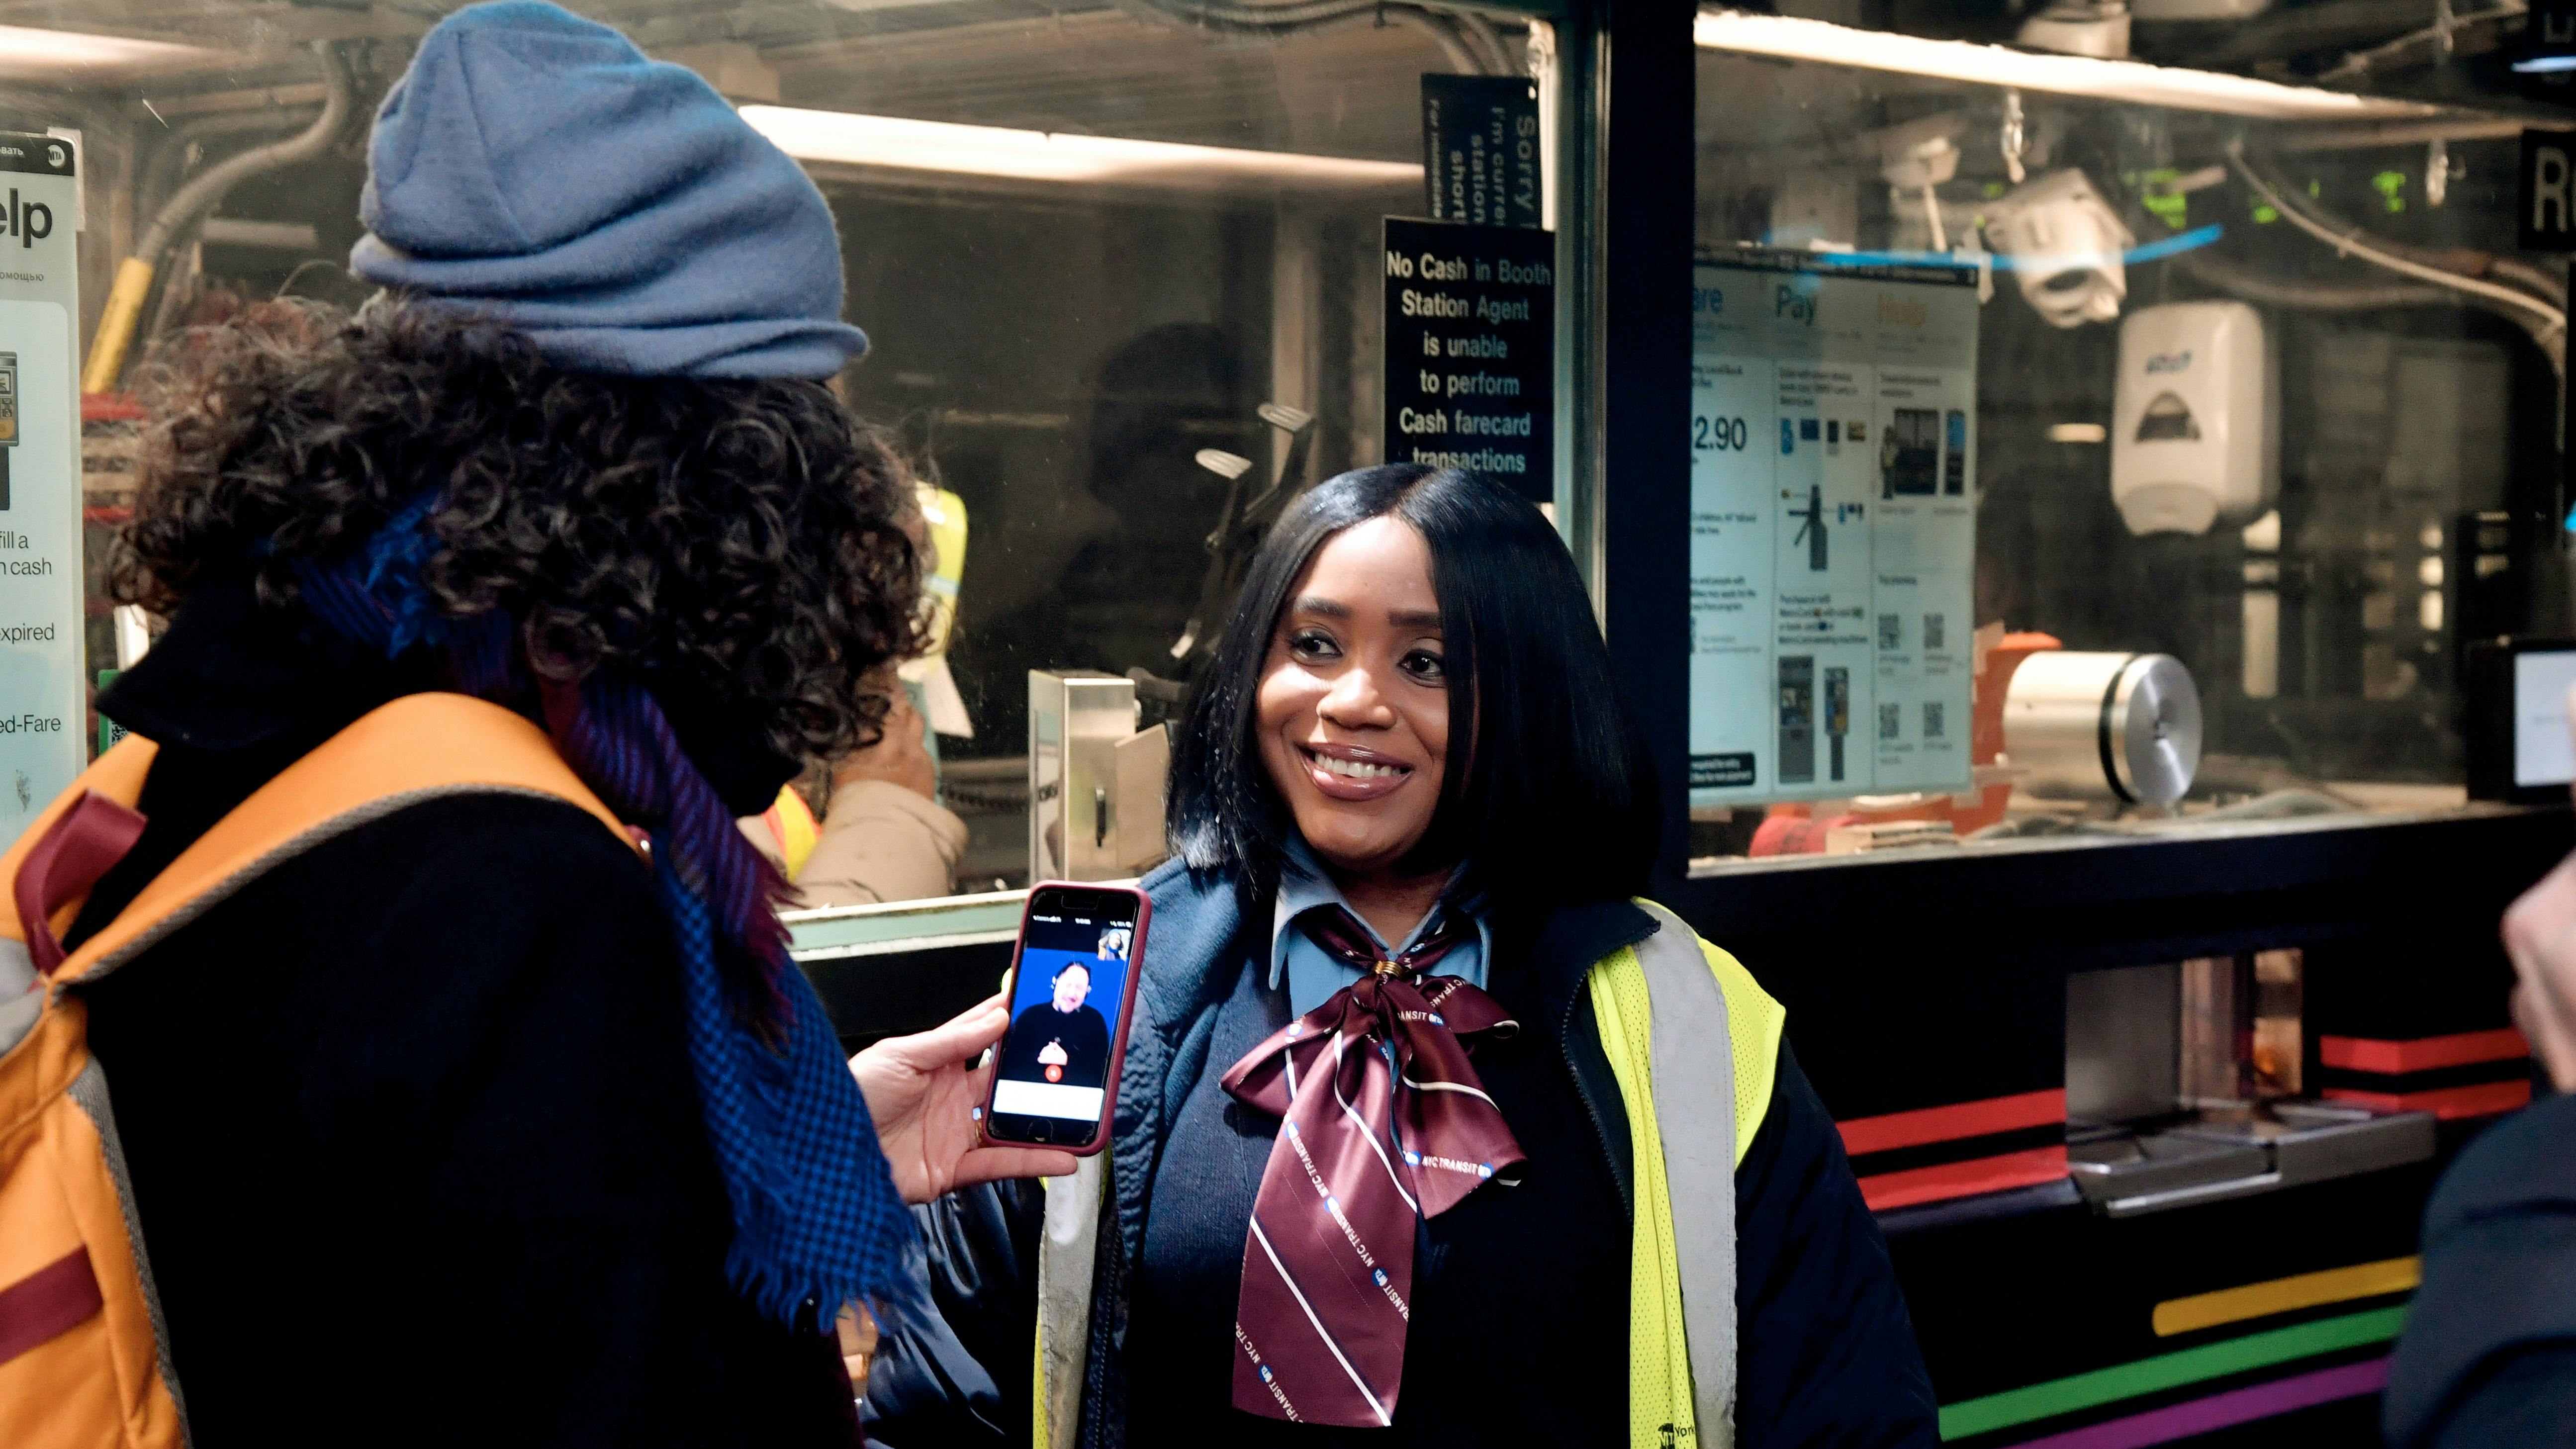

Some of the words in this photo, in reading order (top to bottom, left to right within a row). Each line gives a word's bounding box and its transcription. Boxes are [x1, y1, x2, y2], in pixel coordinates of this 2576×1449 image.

[0, 147, 23, 155] вать
[1514, 115, 1537, 212] Sorry
[1450, 150, 1467, 219] short
[1471, 134, 1486, 223] station
[0, 187, 52, 249] lp
[1386, 250, 1413, 278] No
[1420, 252, 1467, 280] Cash
[1475, 257, 1491, 281] in
[1498, 259, 1551, 285] Booth
[1402, 289, 1469, 317] Station
[1476, 294, 1529, 325] Agent
[1777, 285, 1818, 327] Pay
[1423, 330, 1440, 357] is
[1447, 334, 1507, 359] unable
[1420, 369, 1440, 393] to
[1447, 370, 1519, 398] perform
[1399, 407, 1447, 434] Cash
[1455, 409, 1531, 436] farecard
[1694, 416, 1747, 452] 2.90
[1413, 447, 1525, 472] transactions
[18, 535, 29, 549] a
[10, 557, 52, 575] cash
[0, 622, 54, 644] xpired
[1290, 1135, 1317, 1177] TRANSIT
[1421, 1155, 1439, 1168] NYC
[1439, 1157, 1478, 1175] TRANSIT
[1331, 1209, 1361, 1248] TRANSIT
[1356, 1243, 1375, 1268] NYC
[1244, 1341, 1261, 1364] NYC
[1269, 1381, 1298, 1422] TRANSIT
